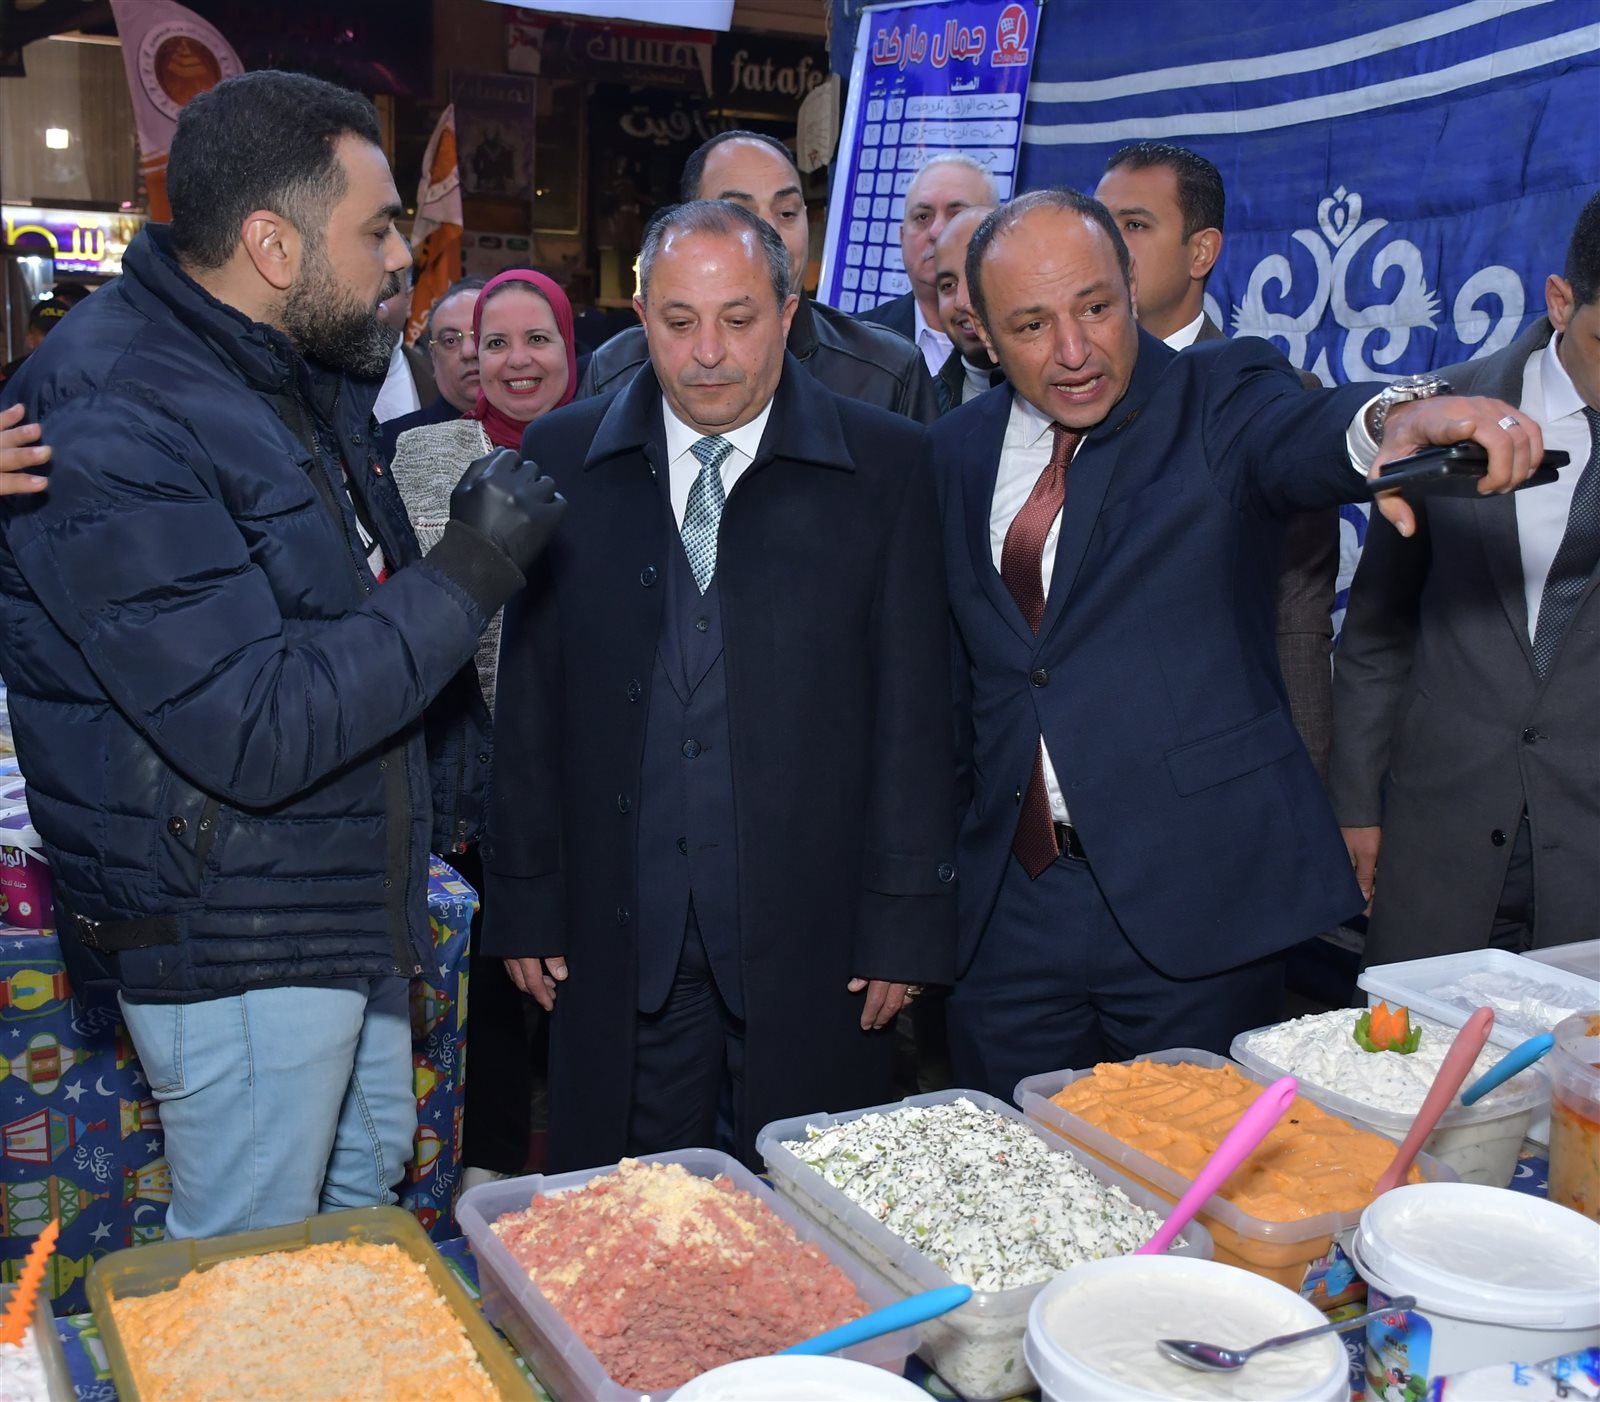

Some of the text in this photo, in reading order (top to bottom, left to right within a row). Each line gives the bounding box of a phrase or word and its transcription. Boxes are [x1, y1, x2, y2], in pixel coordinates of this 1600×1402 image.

[873, 19, 986, 71] جمال ماركت
[729, 49, 824, 99] fatafe
[951, 77, 980, 91] الصنف
[41, 308, 66, 317] POLIC
[0, 846, 27, 867] الورا
